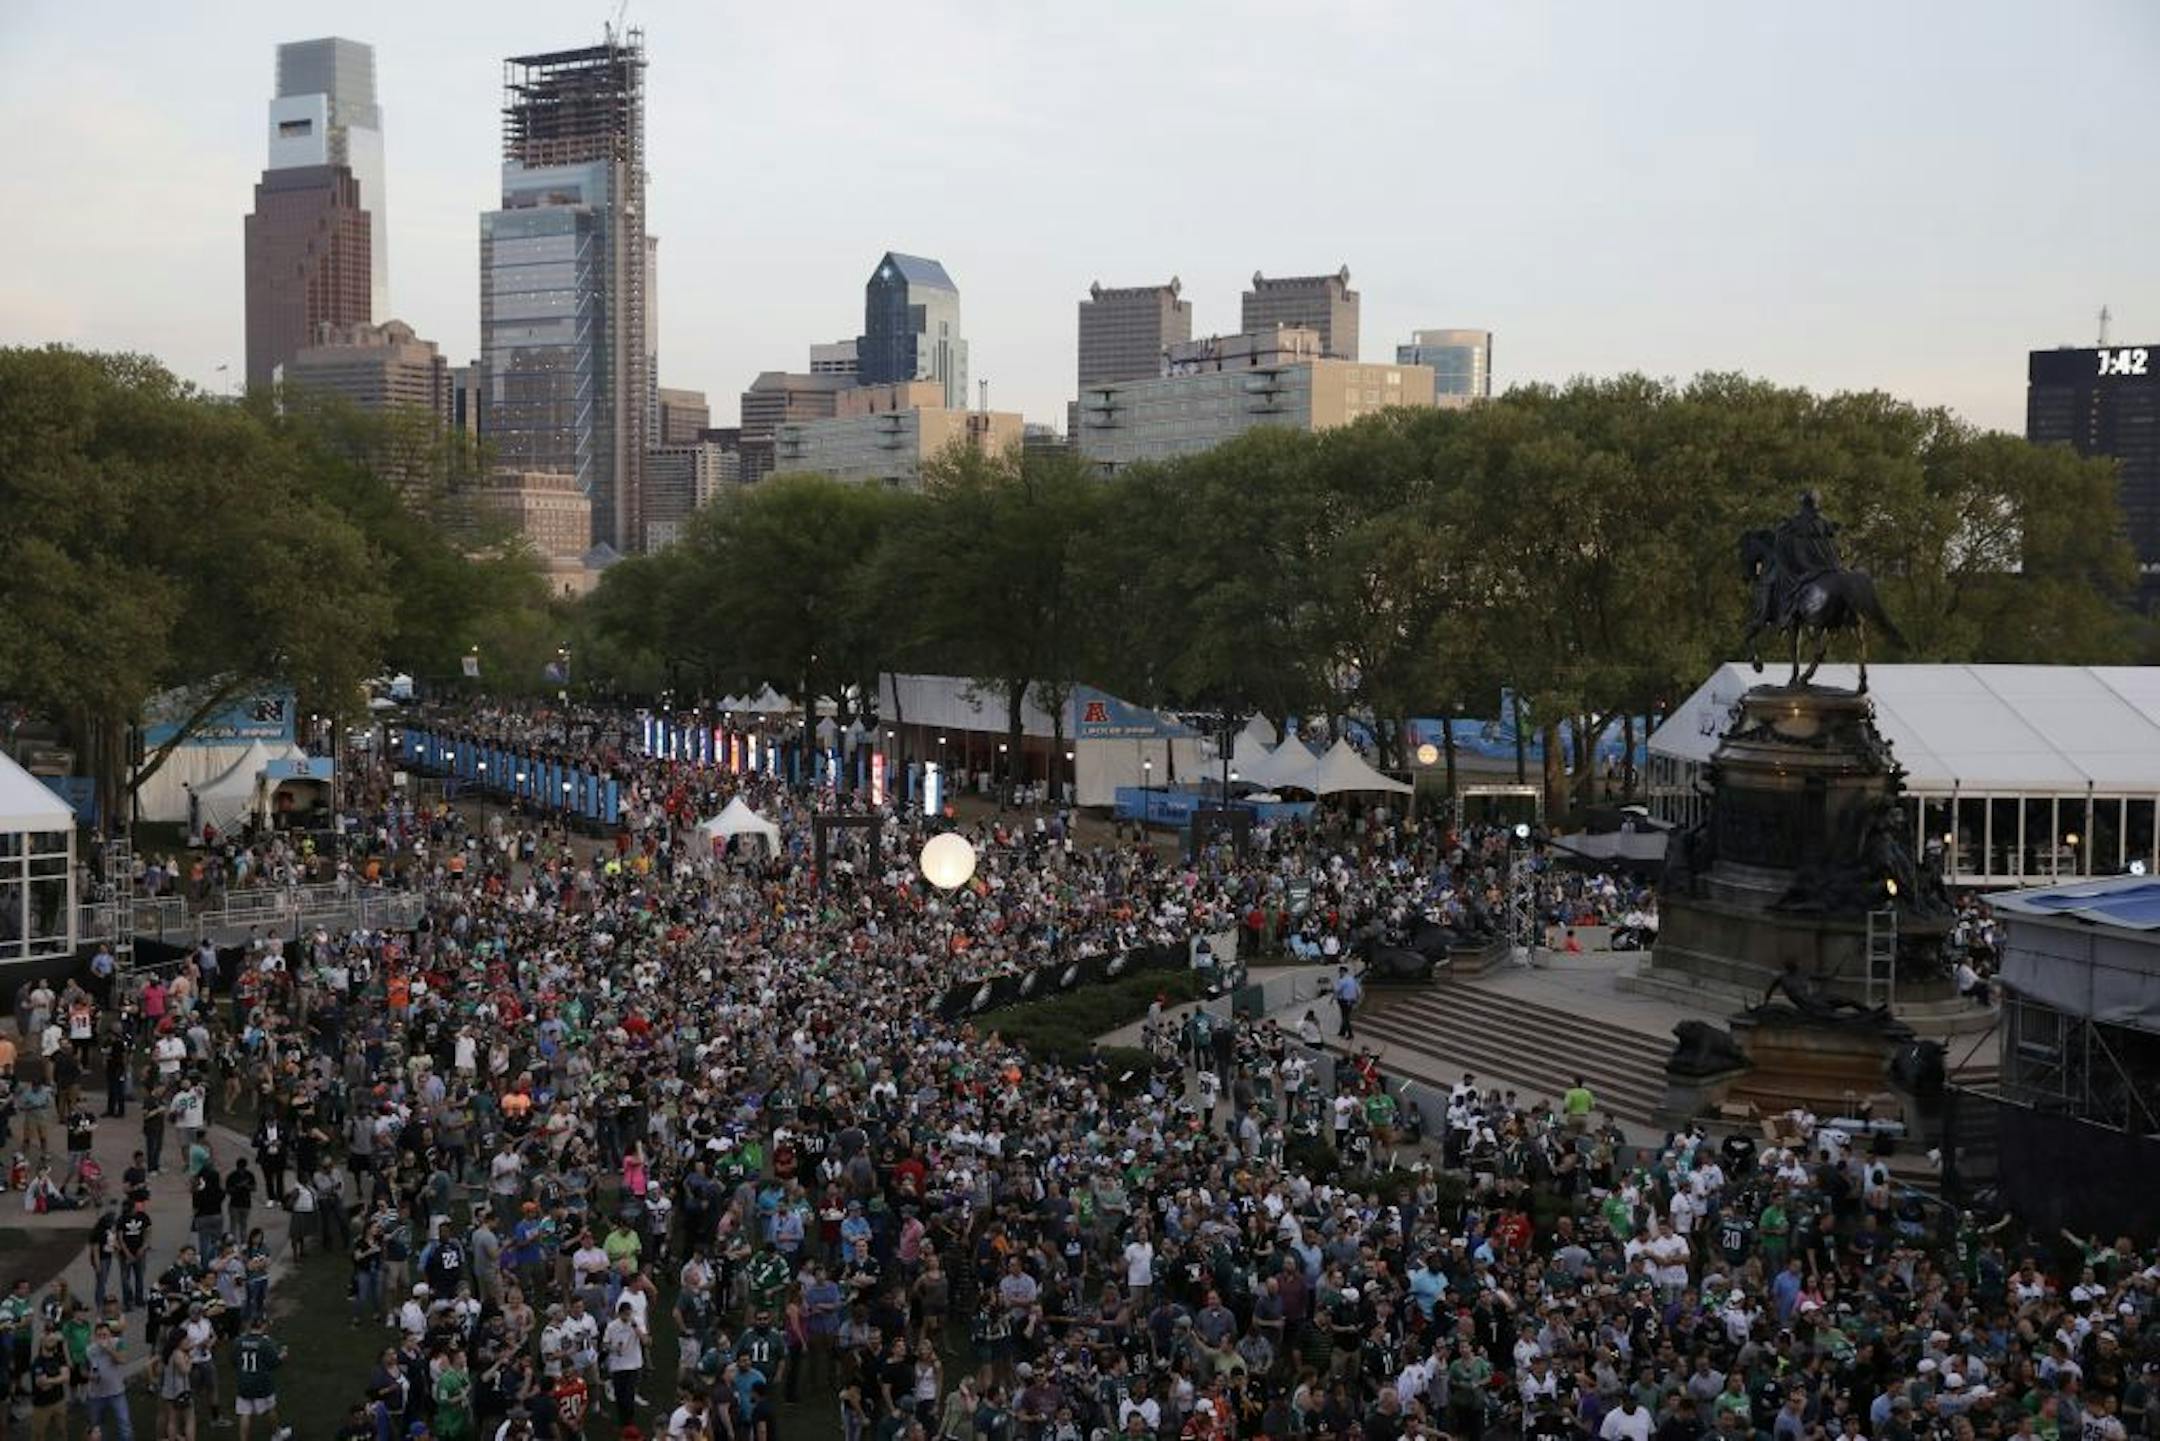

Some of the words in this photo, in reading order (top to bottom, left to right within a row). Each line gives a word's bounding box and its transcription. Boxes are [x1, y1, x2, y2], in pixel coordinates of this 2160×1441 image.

[2097, 348, 2149, 375] 7:42
[1721, 1229, 1741, 1250] 20
[441, 1250, 459, 1270] 22
[241, 1351, 257, 1373] 11
[752, 1341, 769, 1363] 11
[559, 1393, 582, 1420] 20
